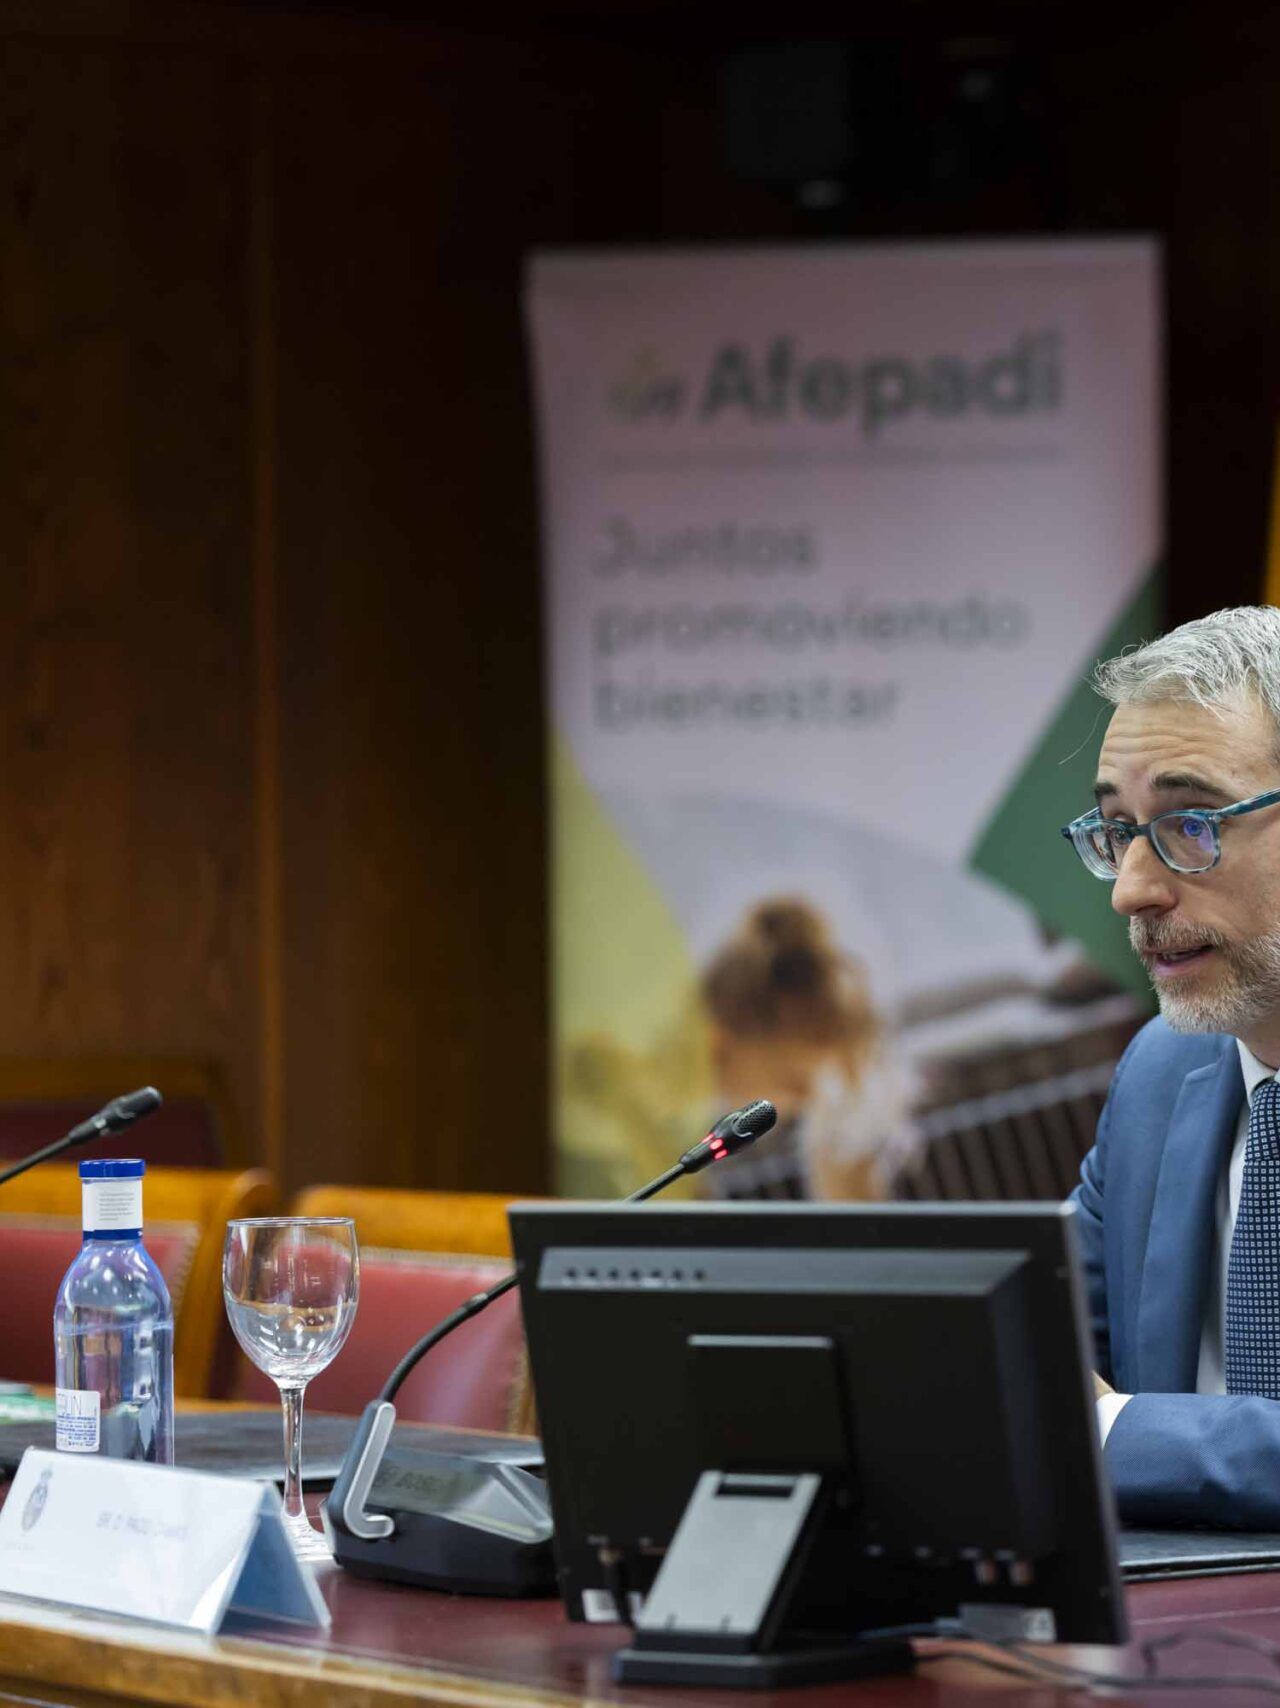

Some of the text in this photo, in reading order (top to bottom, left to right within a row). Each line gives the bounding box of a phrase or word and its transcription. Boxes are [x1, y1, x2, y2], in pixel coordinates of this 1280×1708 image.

[702, 326, 1064, 440] Afepadi
[600, 518, 818, 574] Juntos
[596, 592, 1028, 655] promoviendo
[597, 674, 897, 732] bienestar
